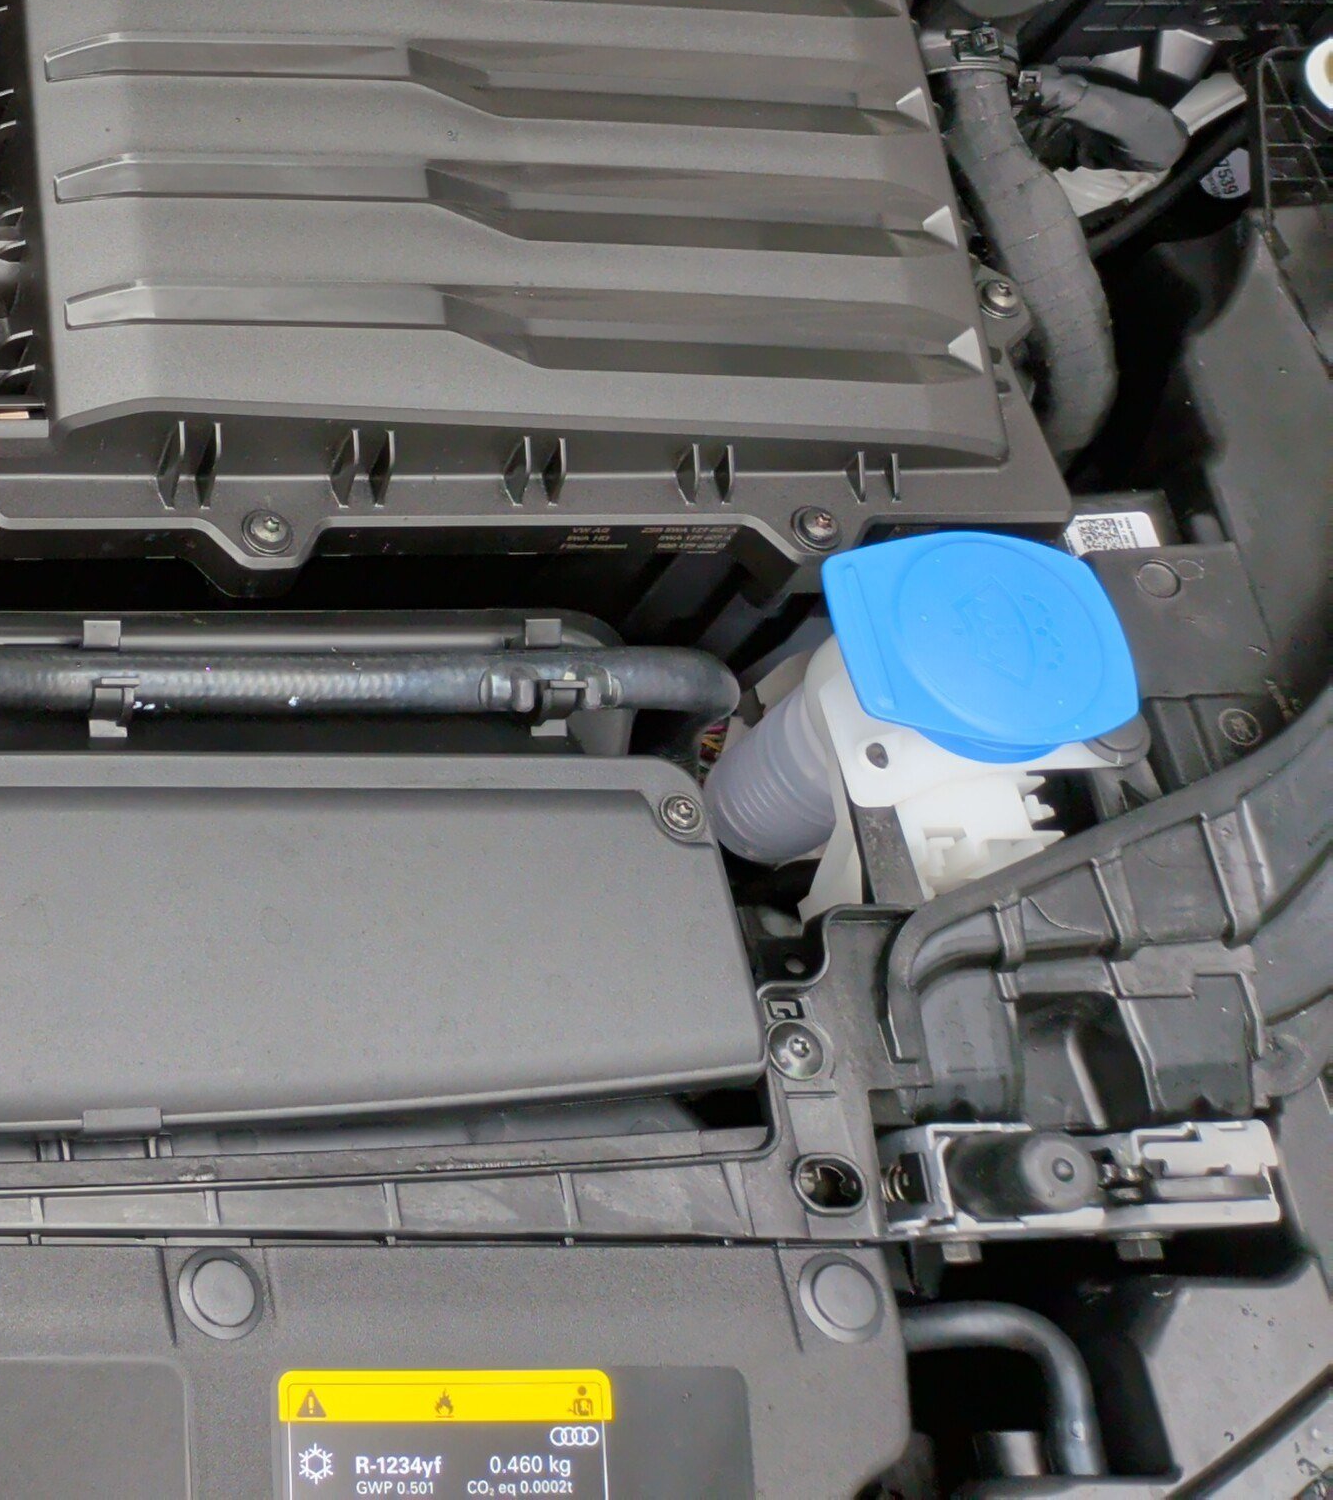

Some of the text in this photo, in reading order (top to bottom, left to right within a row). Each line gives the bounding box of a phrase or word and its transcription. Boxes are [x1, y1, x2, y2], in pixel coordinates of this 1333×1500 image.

[355, 1455, 572, 1478] R-1234yf 0.460 kg
[356, 1480, 394, 1495] GWP
[397, 1480, 435, 1495] 0.501
[498, 1482, 516, 1496] eq
[520, 1480, 574, 1494] 0.0002t
